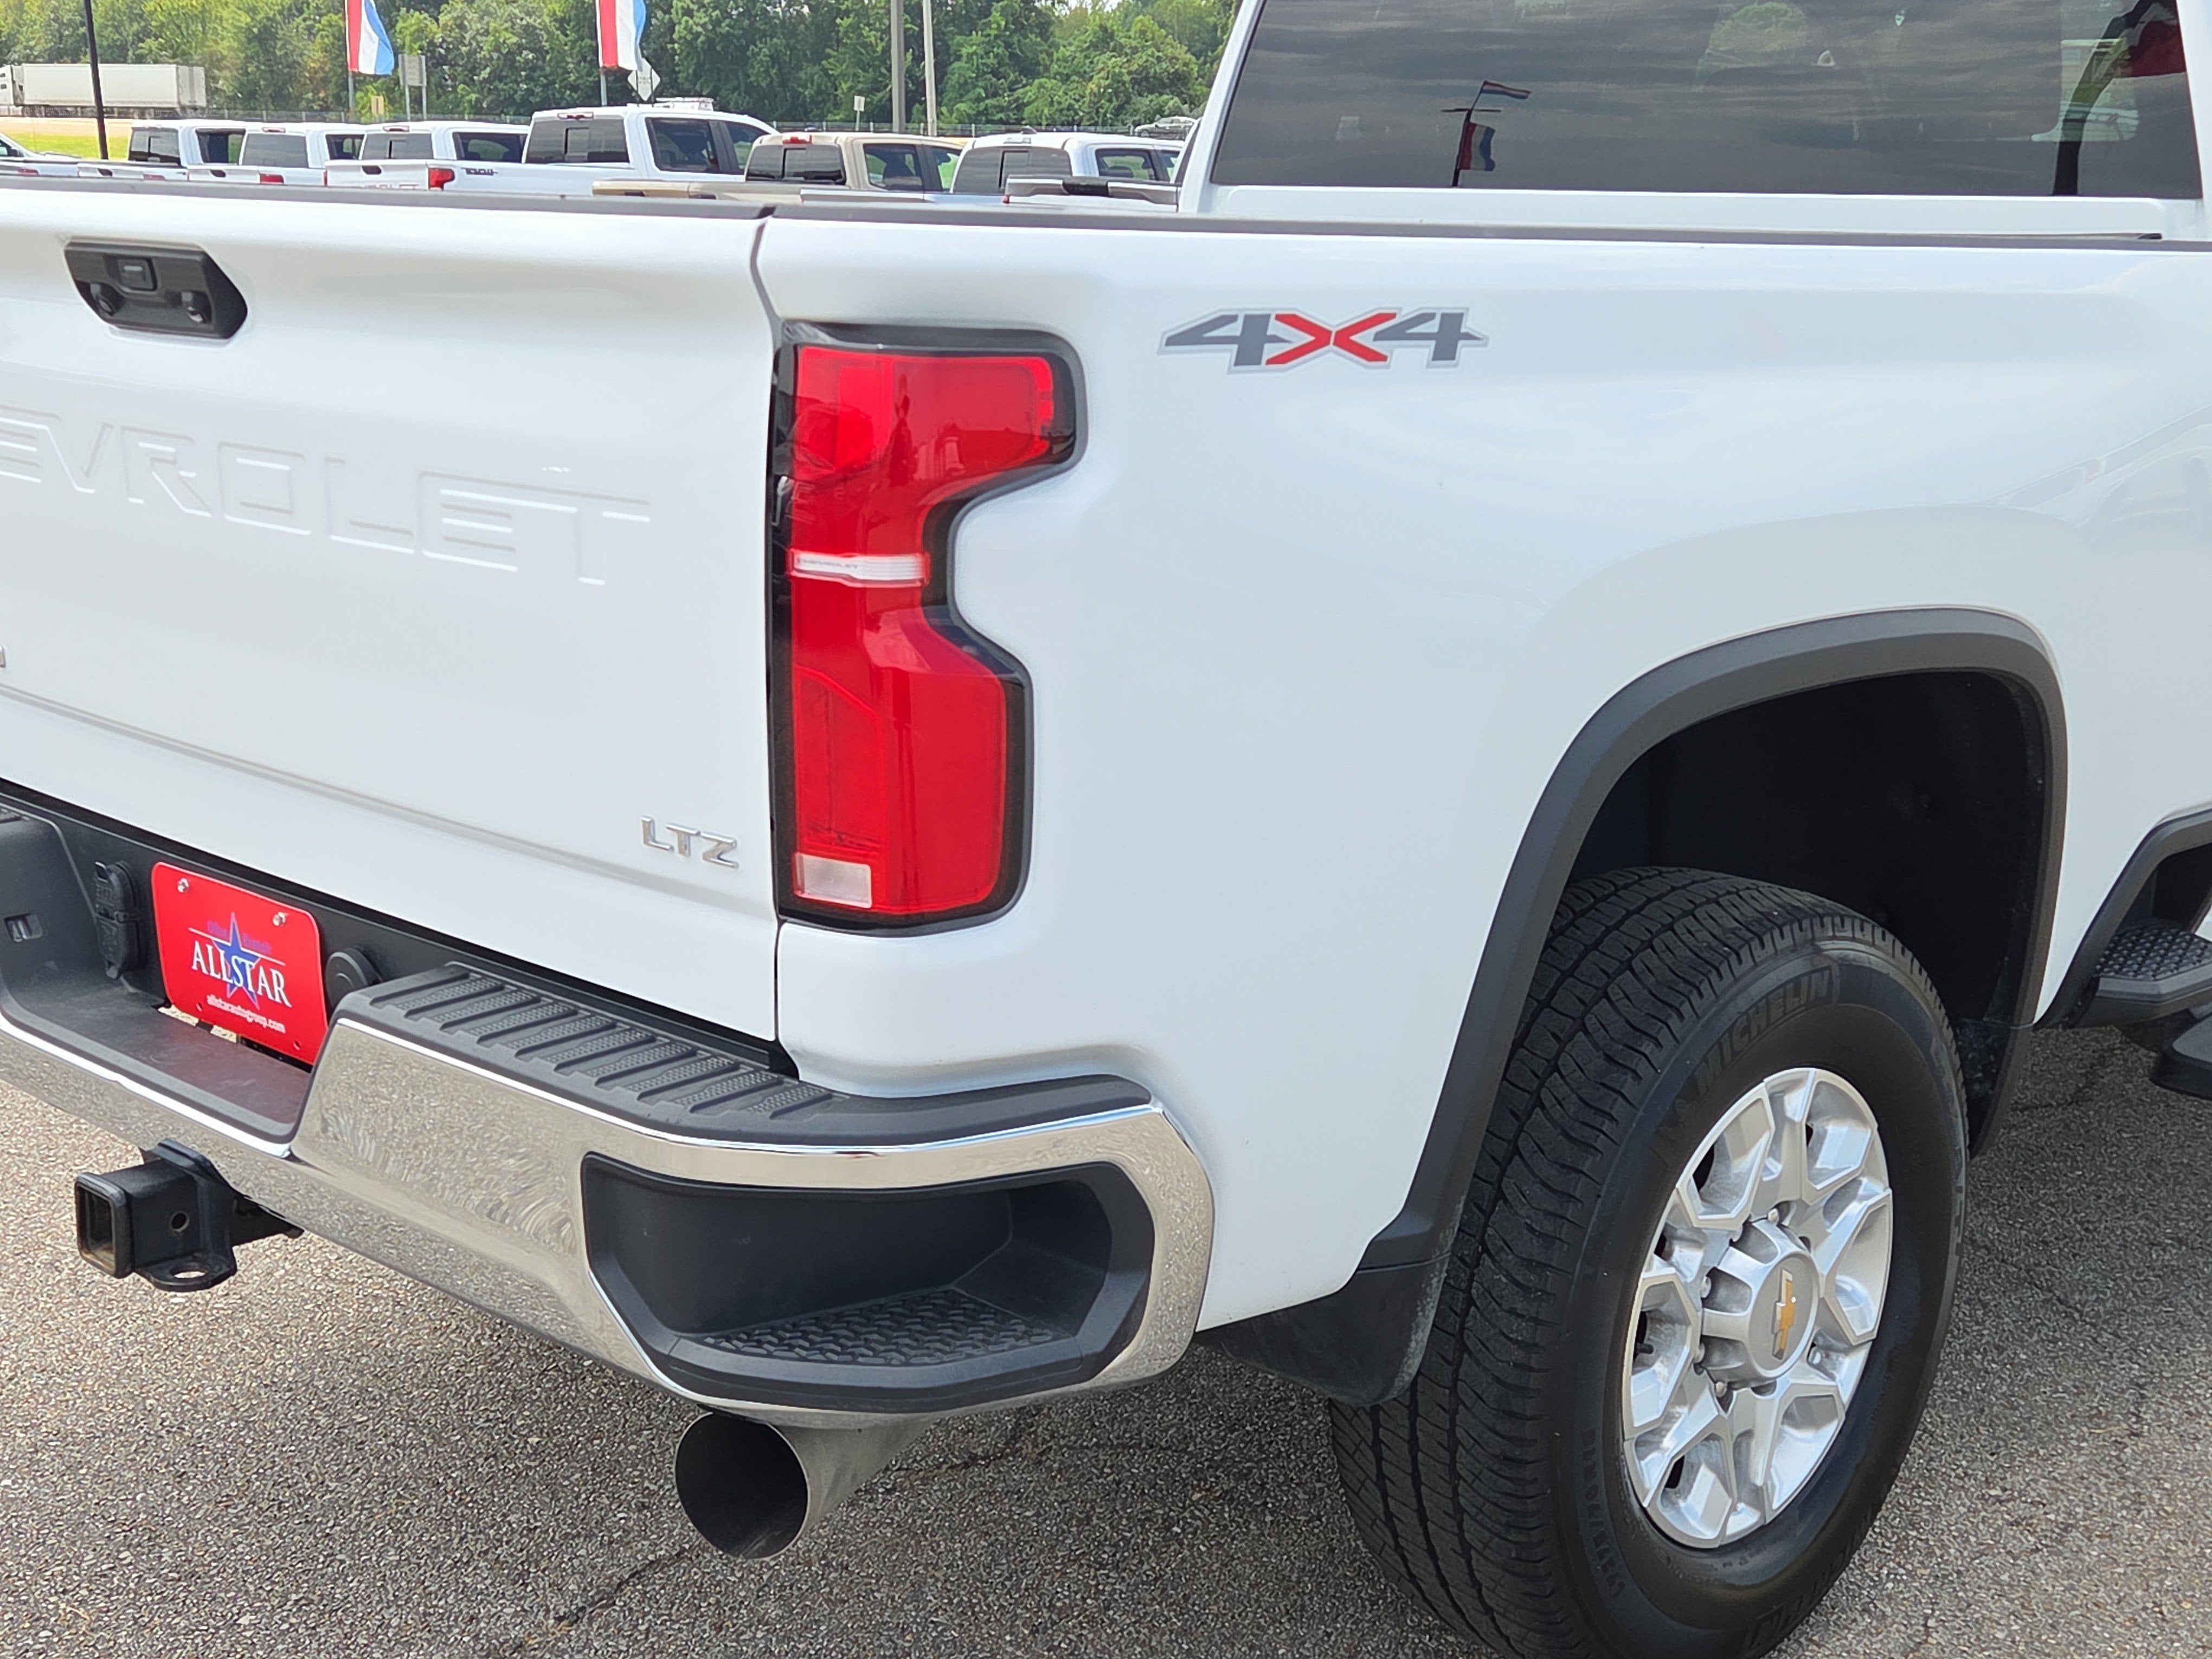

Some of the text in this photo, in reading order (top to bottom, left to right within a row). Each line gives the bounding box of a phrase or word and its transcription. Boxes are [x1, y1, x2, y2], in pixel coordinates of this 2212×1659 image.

[640, 815, 740, 869] LTZ
[191, 940, 292, 1008] ALLSTAR
[1694, 968, 1831, 1098] MICHELIN
